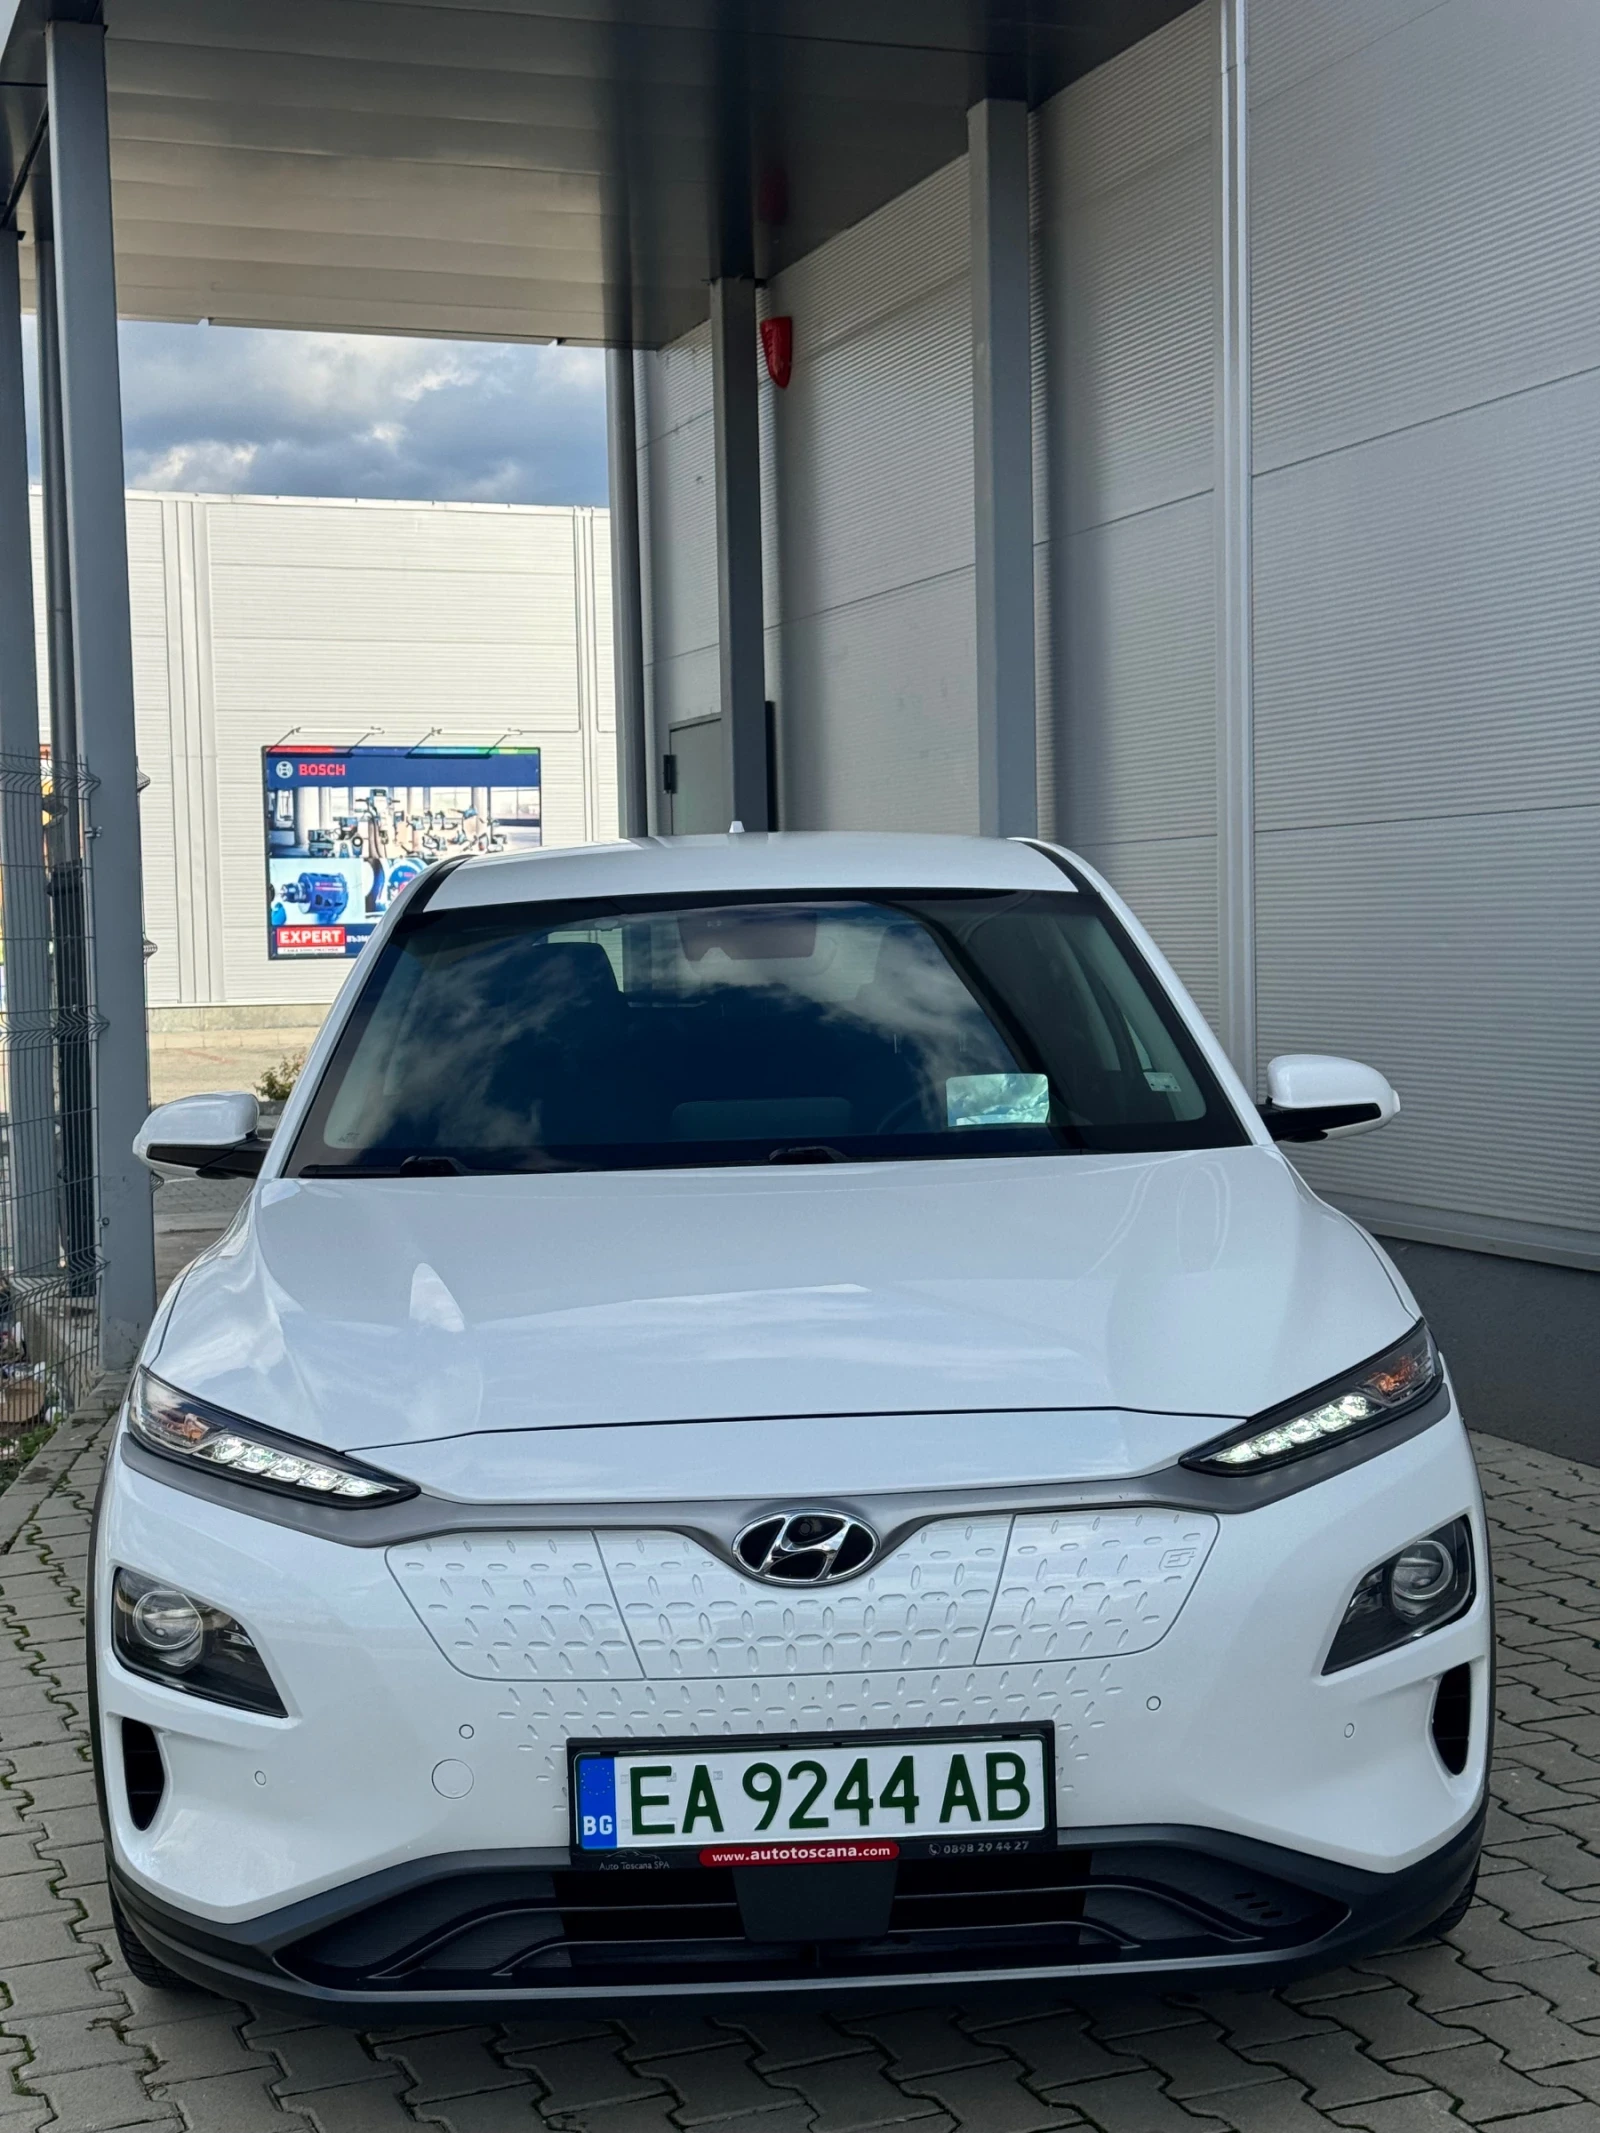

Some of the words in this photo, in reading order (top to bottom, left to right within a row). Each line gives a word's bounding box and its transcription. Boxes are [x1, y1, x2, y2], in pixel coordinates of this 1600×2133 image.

[298, 763, 346, 776] BOSCH
[280, 930, 342, 944] EXPERT
[630, 1764, 725, 1836] EA
[742, 1754, 920, 1832] 9244
[939, 1751, 1031, 1824] AB
[583, 1815, 613, 1836] BG
[712, 1846, 891, 1862] www.autotoscana.com
[943, 1844, 974, 1854] 0898
[977, 1842, 993, 1852] 29
[995, 1841, 1012, 1851] 44
[1014, 1840, 1030, 1850] 27
[599, 1861, 619, 1871] Auto
[621, 1861, 653, 1870] Toscana
[654, 1861, 670, 1869] SPA
